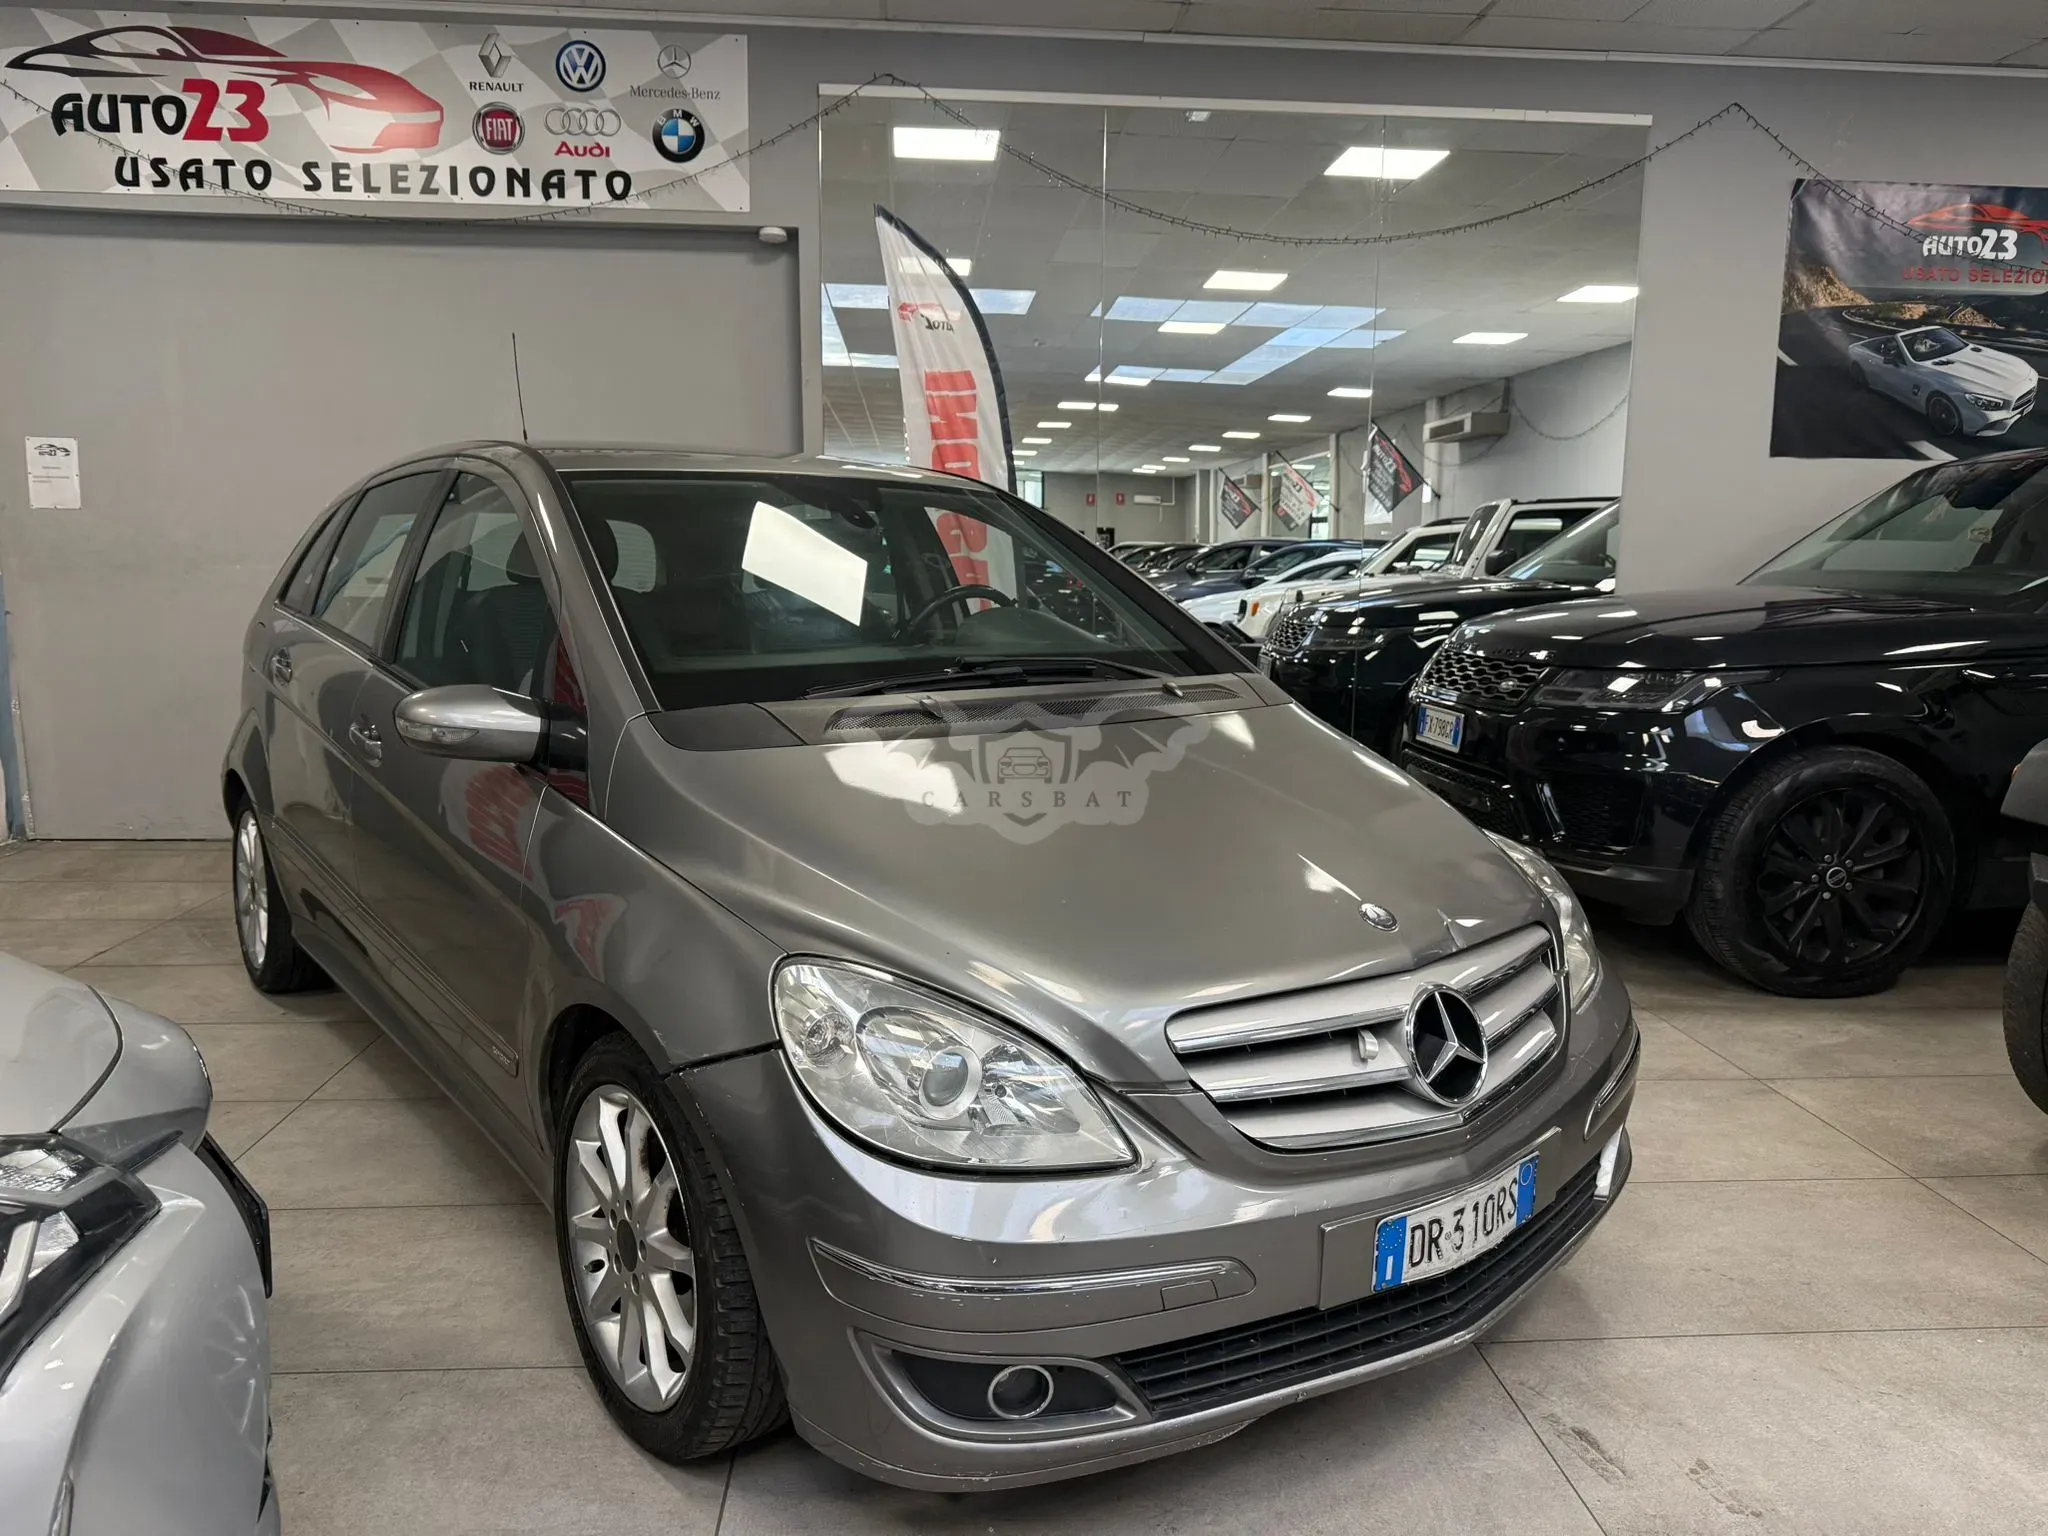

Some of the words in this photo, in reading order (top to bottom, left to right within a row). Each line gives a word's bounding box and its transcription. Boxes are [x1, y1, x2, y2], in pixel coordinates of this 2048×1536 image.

[469, 81, 524, 93] RENAULT
[629, 84, 721, 100] Mercedes-Benz
[51, 78, 269, 143] AUTO23
[657, 108, 700, 128] BMW
[485, 117, 514, 141] FIAT
[554, 140, 611, 158] Audi
[114, 155, 273, 193] USATO
[301, 160, 632, 202] SELEZIONATO
[1922, 228, 2018, 260] AUTO23
[1902, 265, 1962, 282] USATO
[1408, 1218, 1444, 1268] DR
[1452, 1177, 1518, 1252] 310RS
